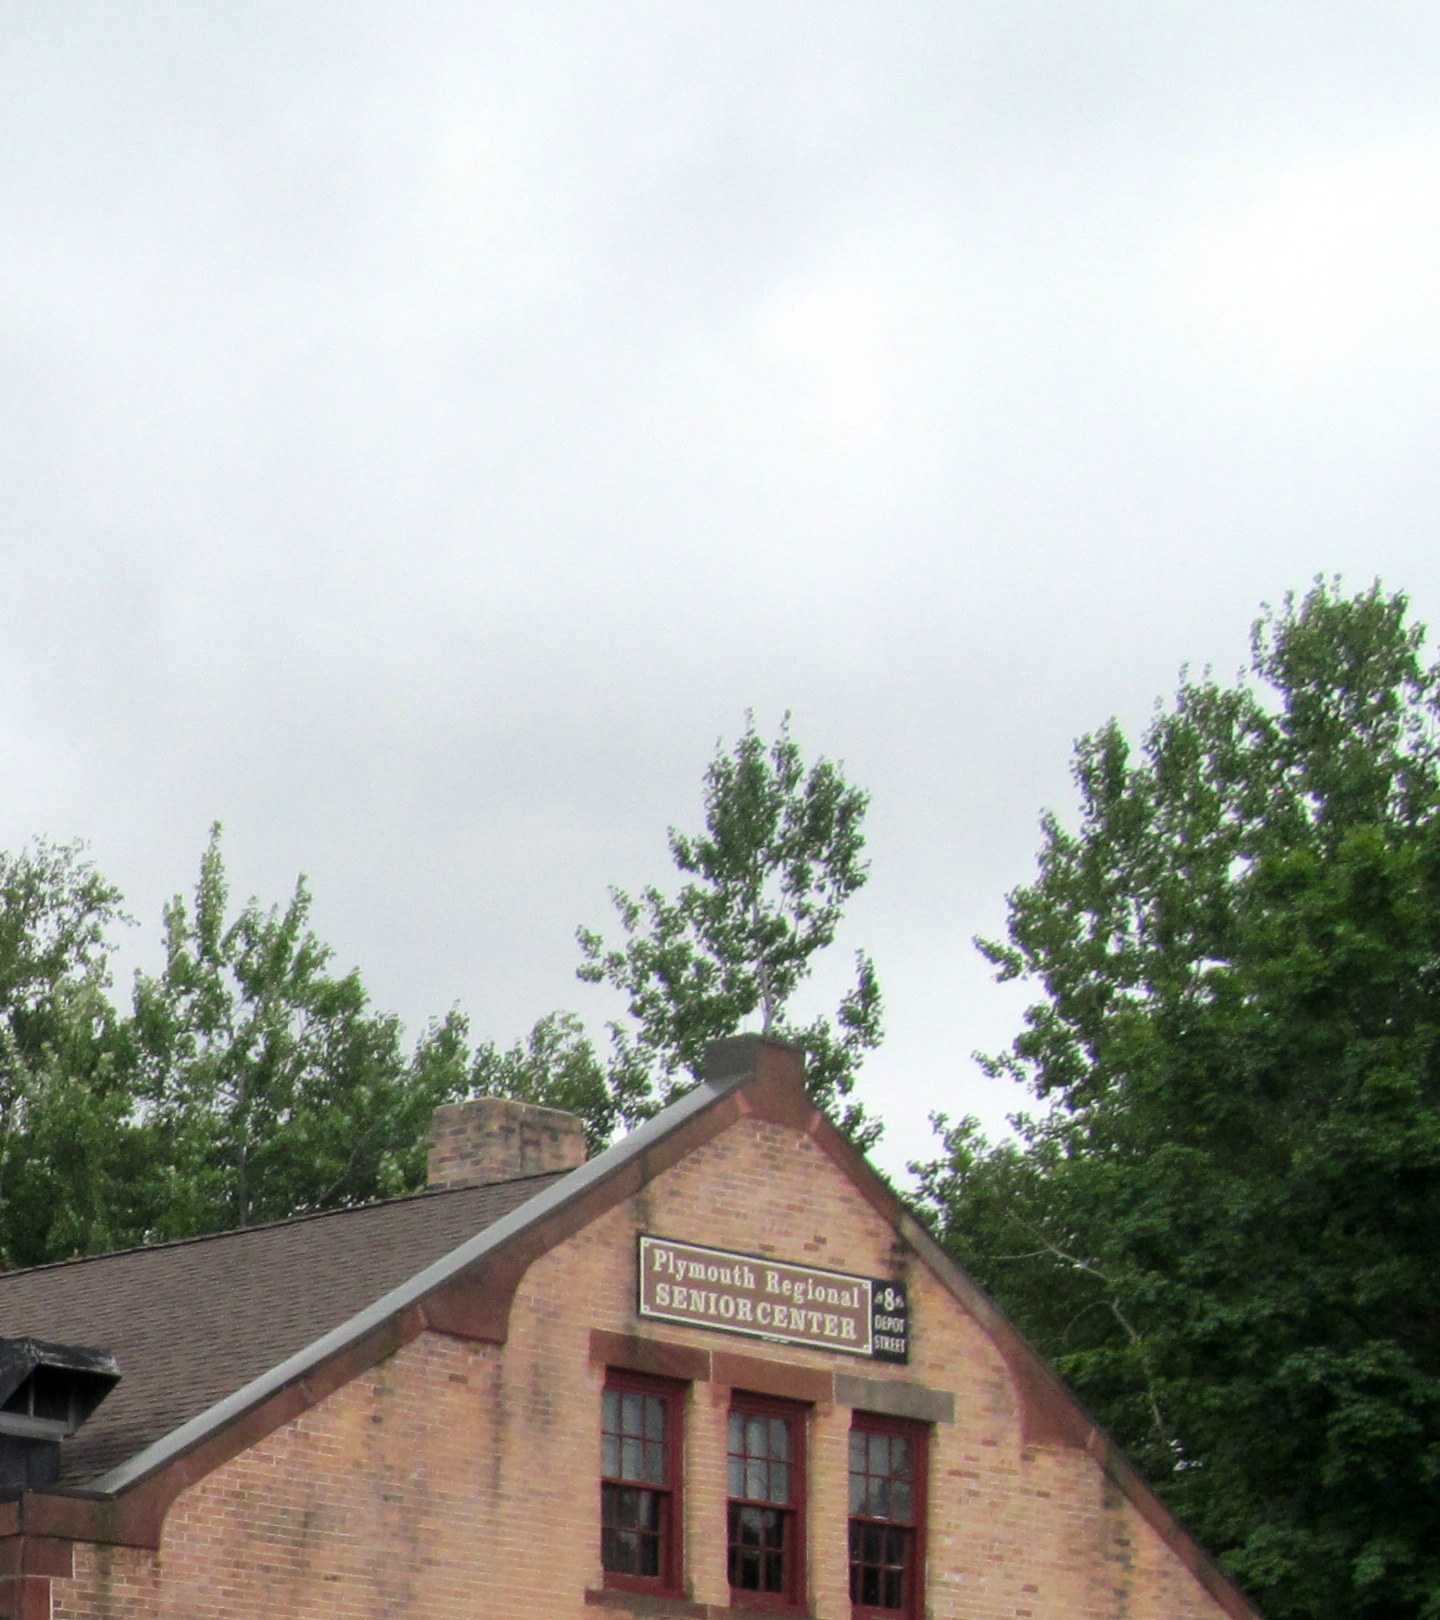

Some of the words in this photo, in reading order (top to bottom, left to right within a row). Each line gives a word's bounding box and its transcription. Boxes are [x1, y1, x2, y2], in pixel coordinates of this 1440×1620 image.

[653, 1248, 756, 1289] Plymouth
[765, 1270, 860, 1308] Regional
[655, 1282, 754, 1322] SENIOR
[756, 1301, 857, 1340] CENTER
[884, 1287, 895, 1311] 8
[874, 1314, 905, 1333] DEPOT
[874, 1334, 906, 1354] STREET
